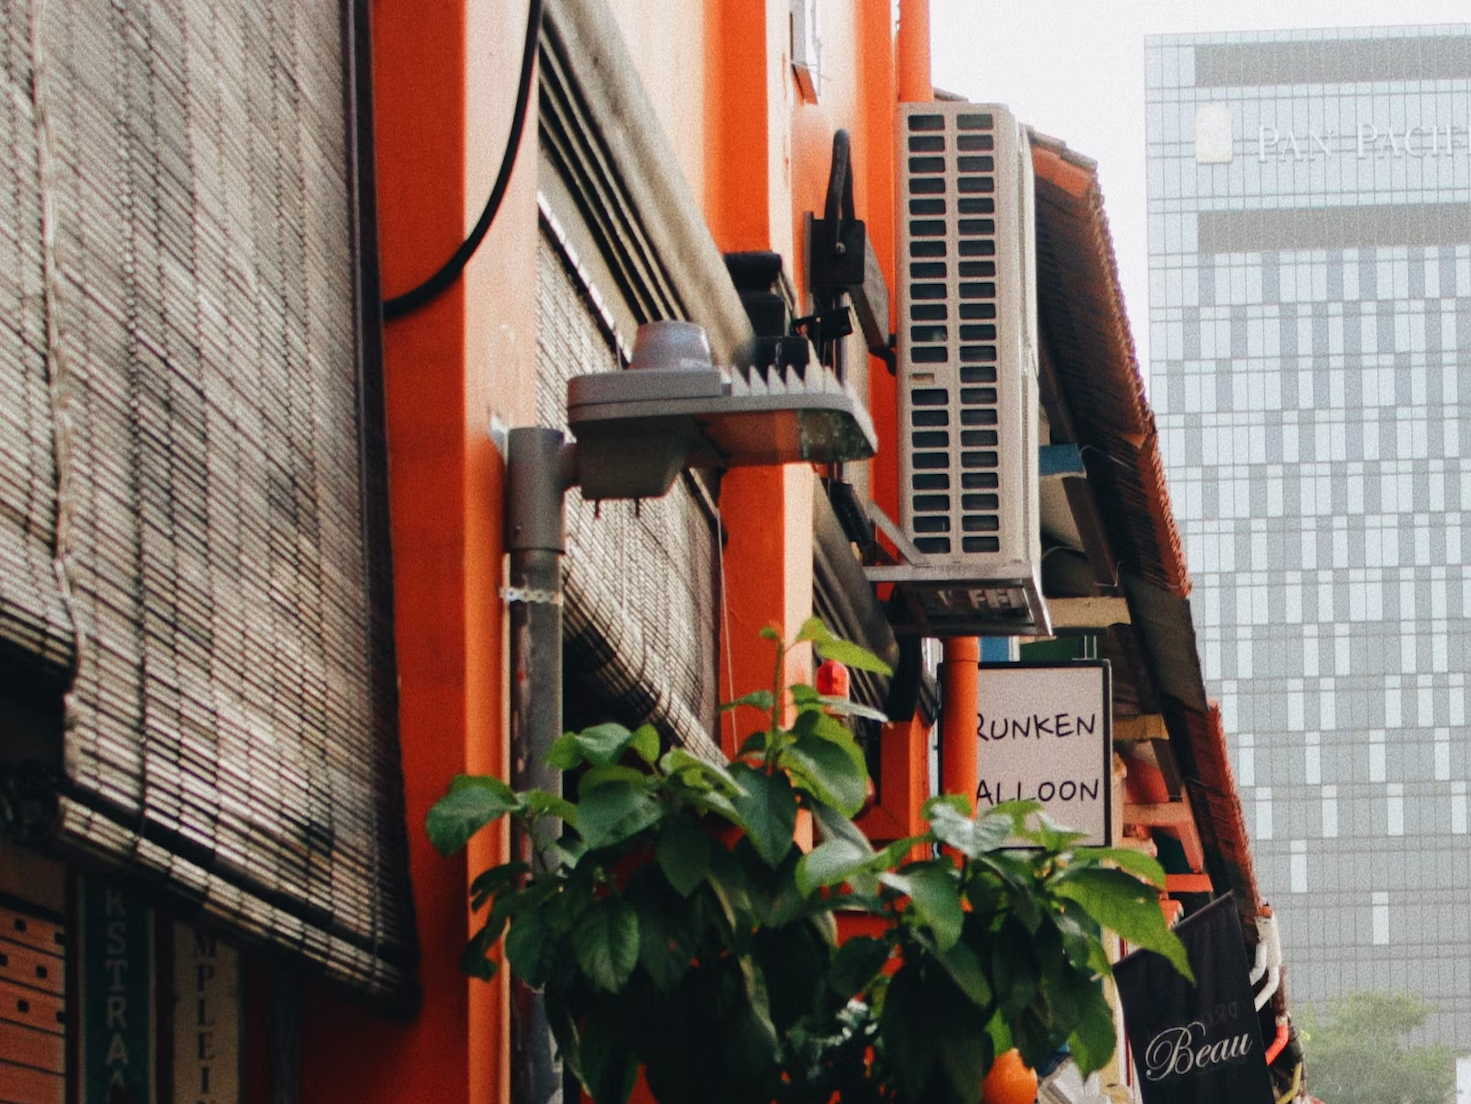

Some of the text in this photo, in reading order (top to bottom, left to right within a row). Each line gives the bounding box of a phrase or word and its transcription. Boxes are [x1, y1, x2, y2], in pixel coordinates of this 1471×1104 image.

[1257, 125, 1336, 163] PAN
[977, 712, 1096, 741] RUNKEN
[977, 778, 1099, 804] ALLOON
[1145, 1021, 1253, 1081] Beau
